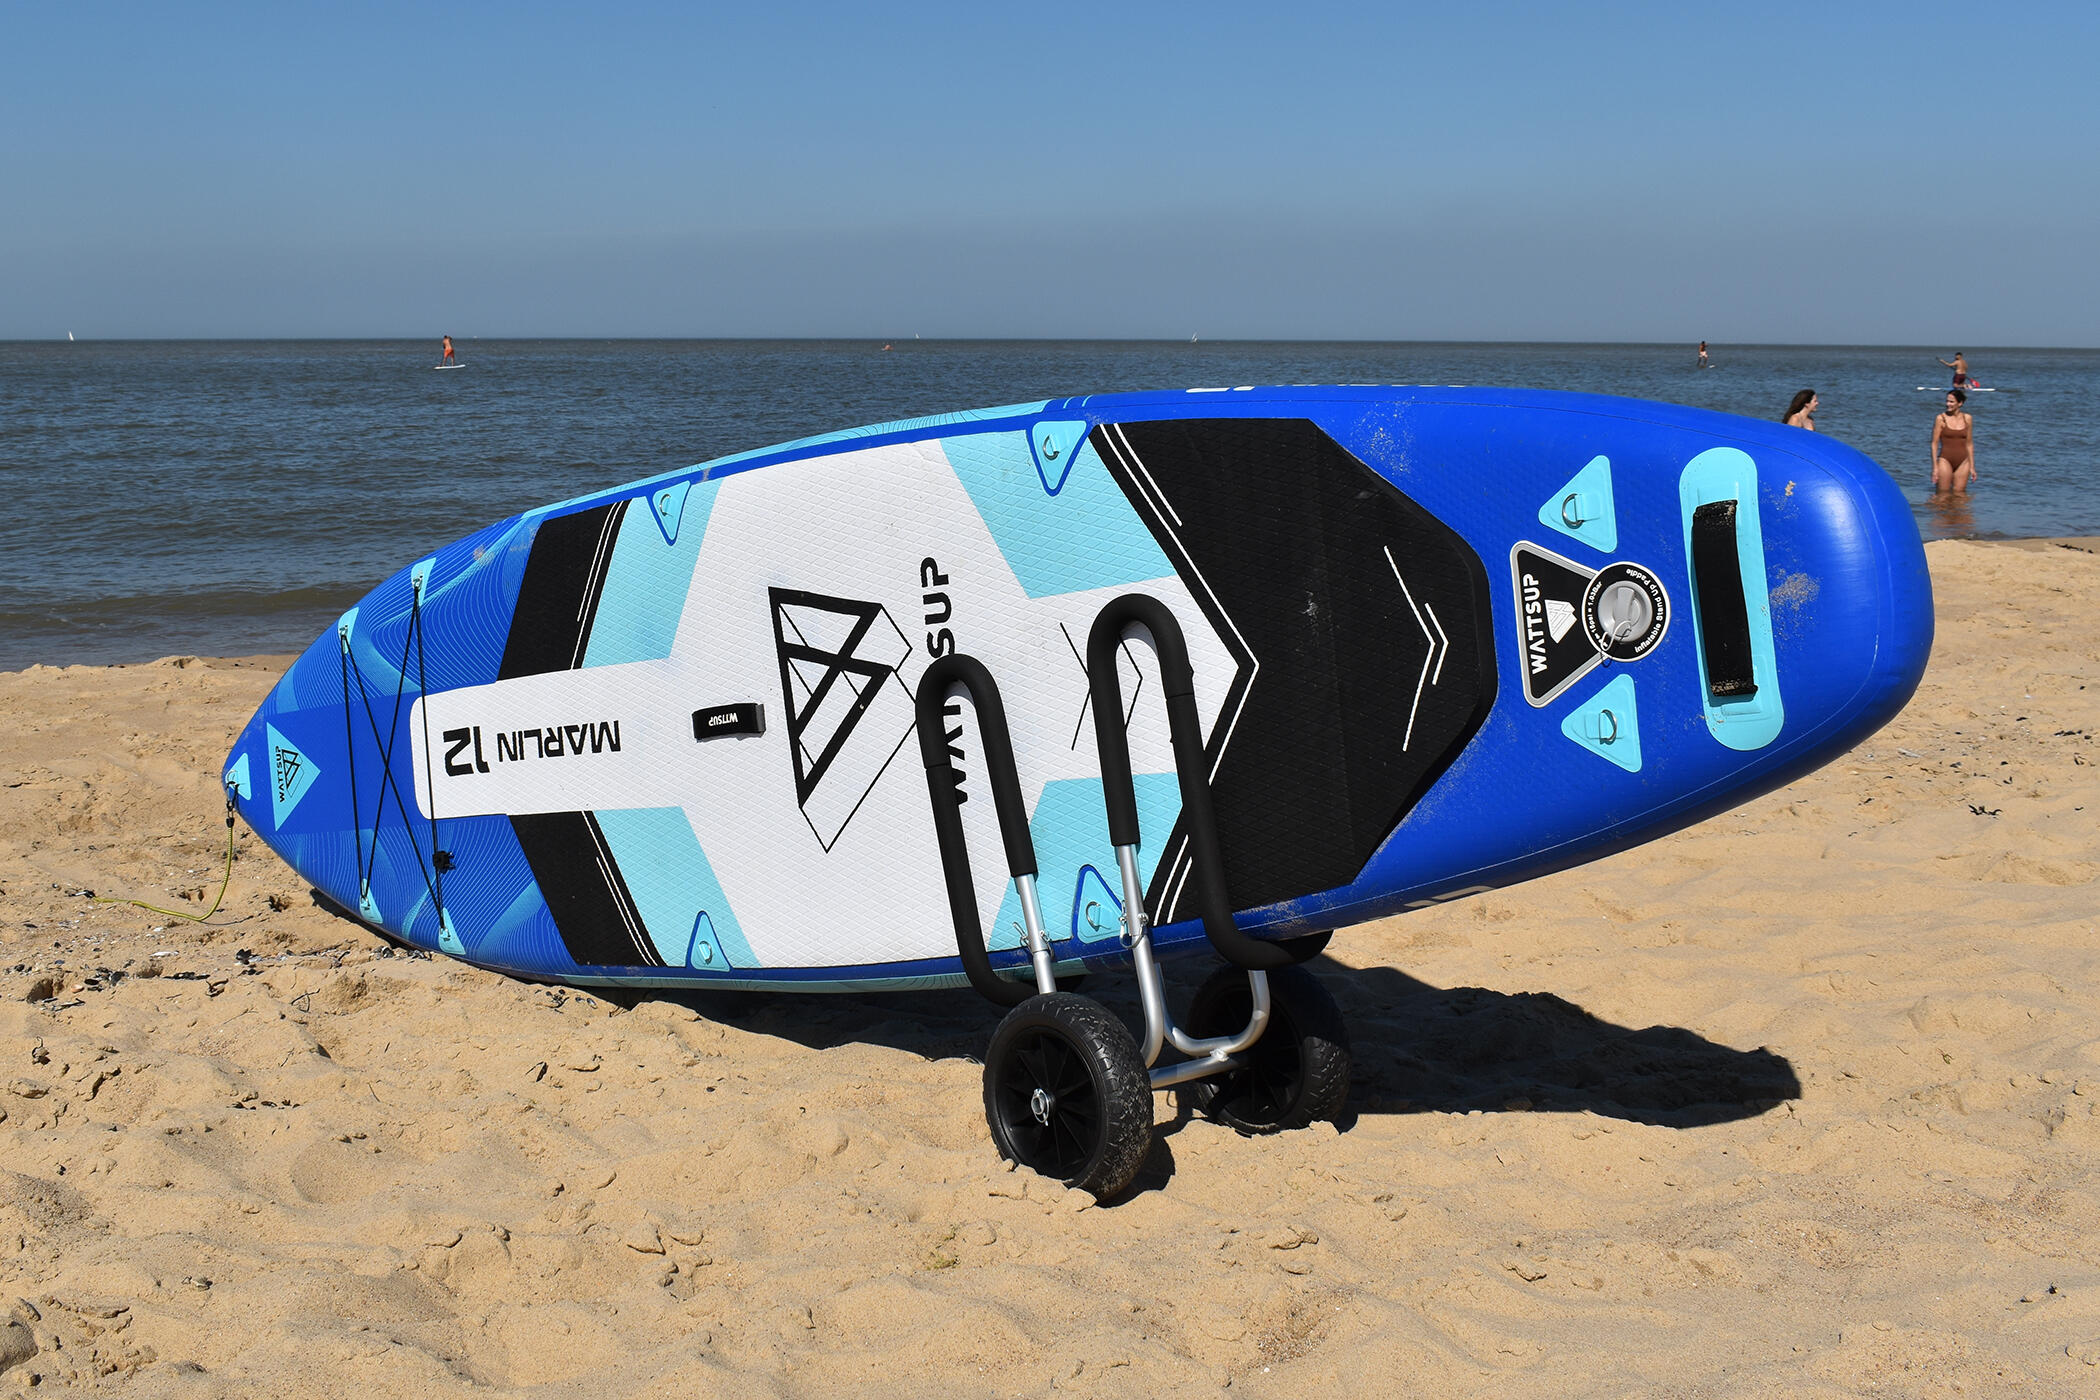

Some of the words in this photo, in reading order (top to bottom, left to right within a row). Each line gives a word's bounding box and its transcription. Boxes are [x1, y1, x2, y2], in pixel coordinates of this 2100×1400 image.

[1626, 568, 1651, 586] Paddle
[1649, 584, 1659, 596] Up
[1522, 573, 1548, 675] WATTSUP
[1655, 596, 1664, 621] Stand
[1634, 623, 1661, 653] Inflatable
[443, 726, 490, 777] 12
[496, 720, 622, 763] MARLIN
[275, 745, 286, 803] WATTSUP
